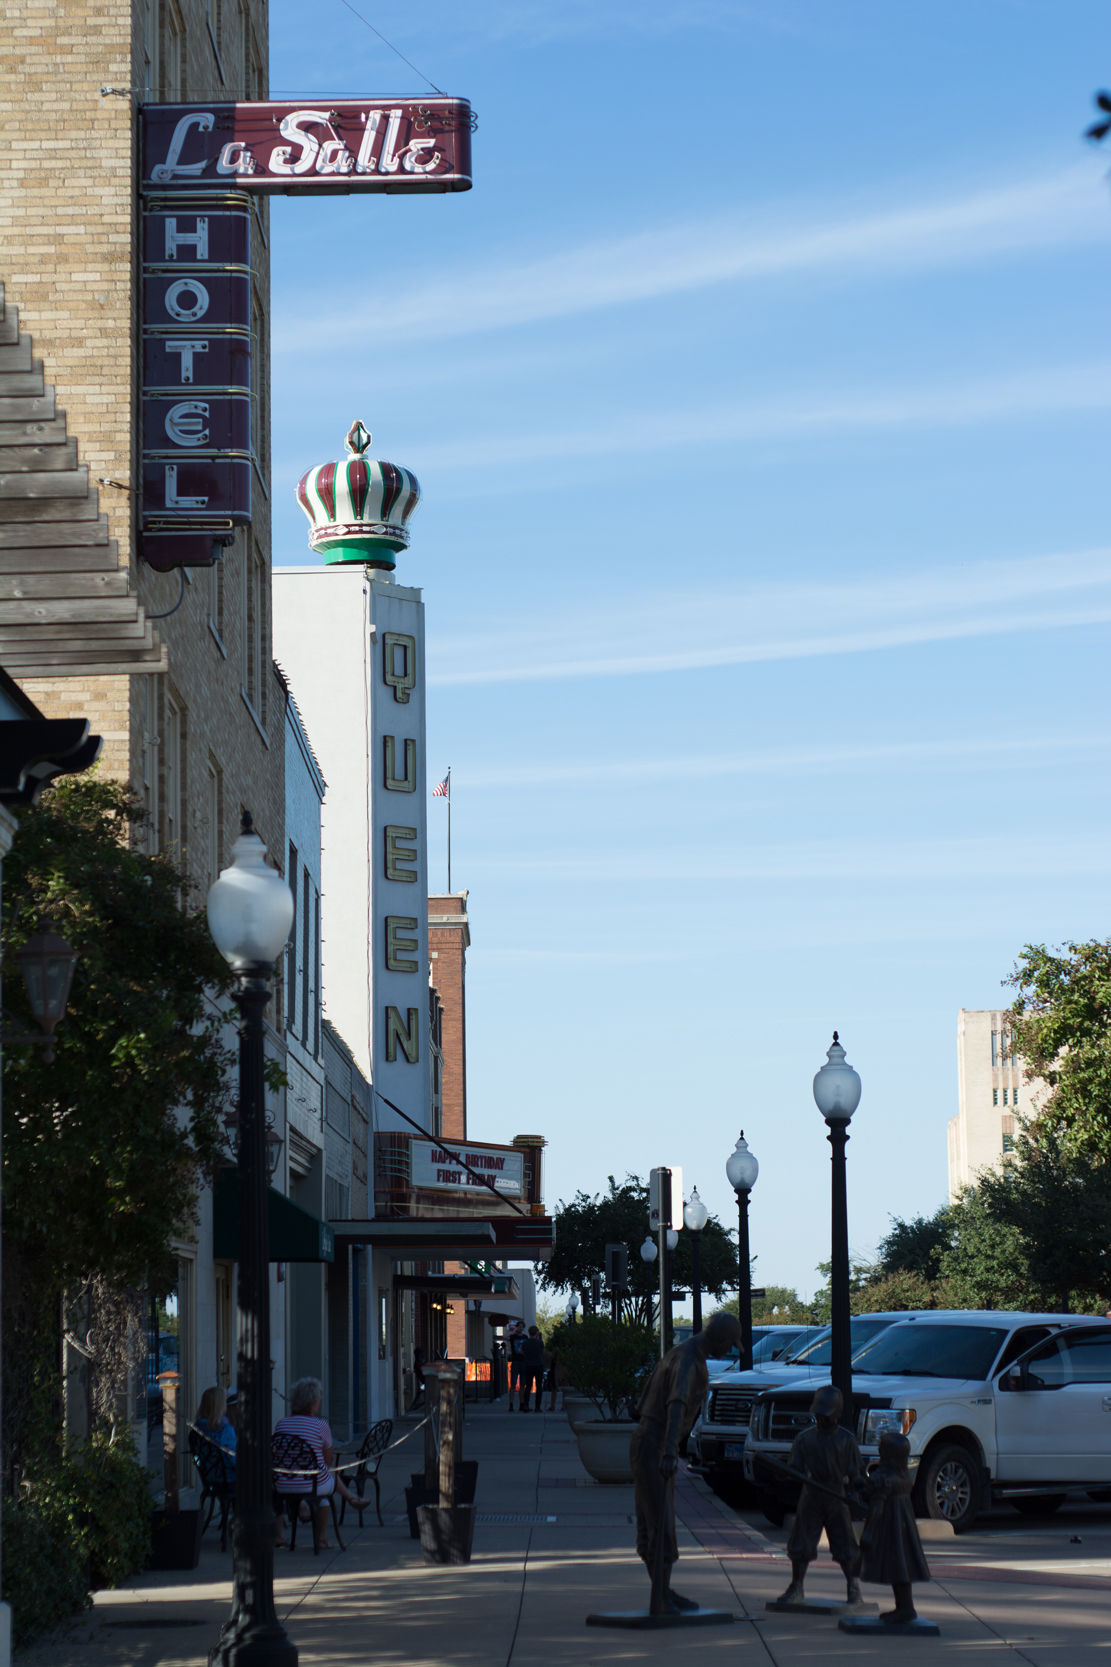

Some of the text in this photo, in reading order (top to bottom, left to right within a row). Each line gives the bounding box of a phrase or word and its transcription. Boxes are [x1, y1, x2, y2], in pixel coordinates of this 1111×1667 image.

[152, 108, 441, 180] La Salle
[164, 216, 210, 509] HOTEL
[383, 632, 419, 1063] QUEEN
[431, 1149, 505, 1170] HAPPY BIRTHDAY
[437, 1169, 462, 1184] FIRST
[467, 1173, 496, 1188] FRIDAY
